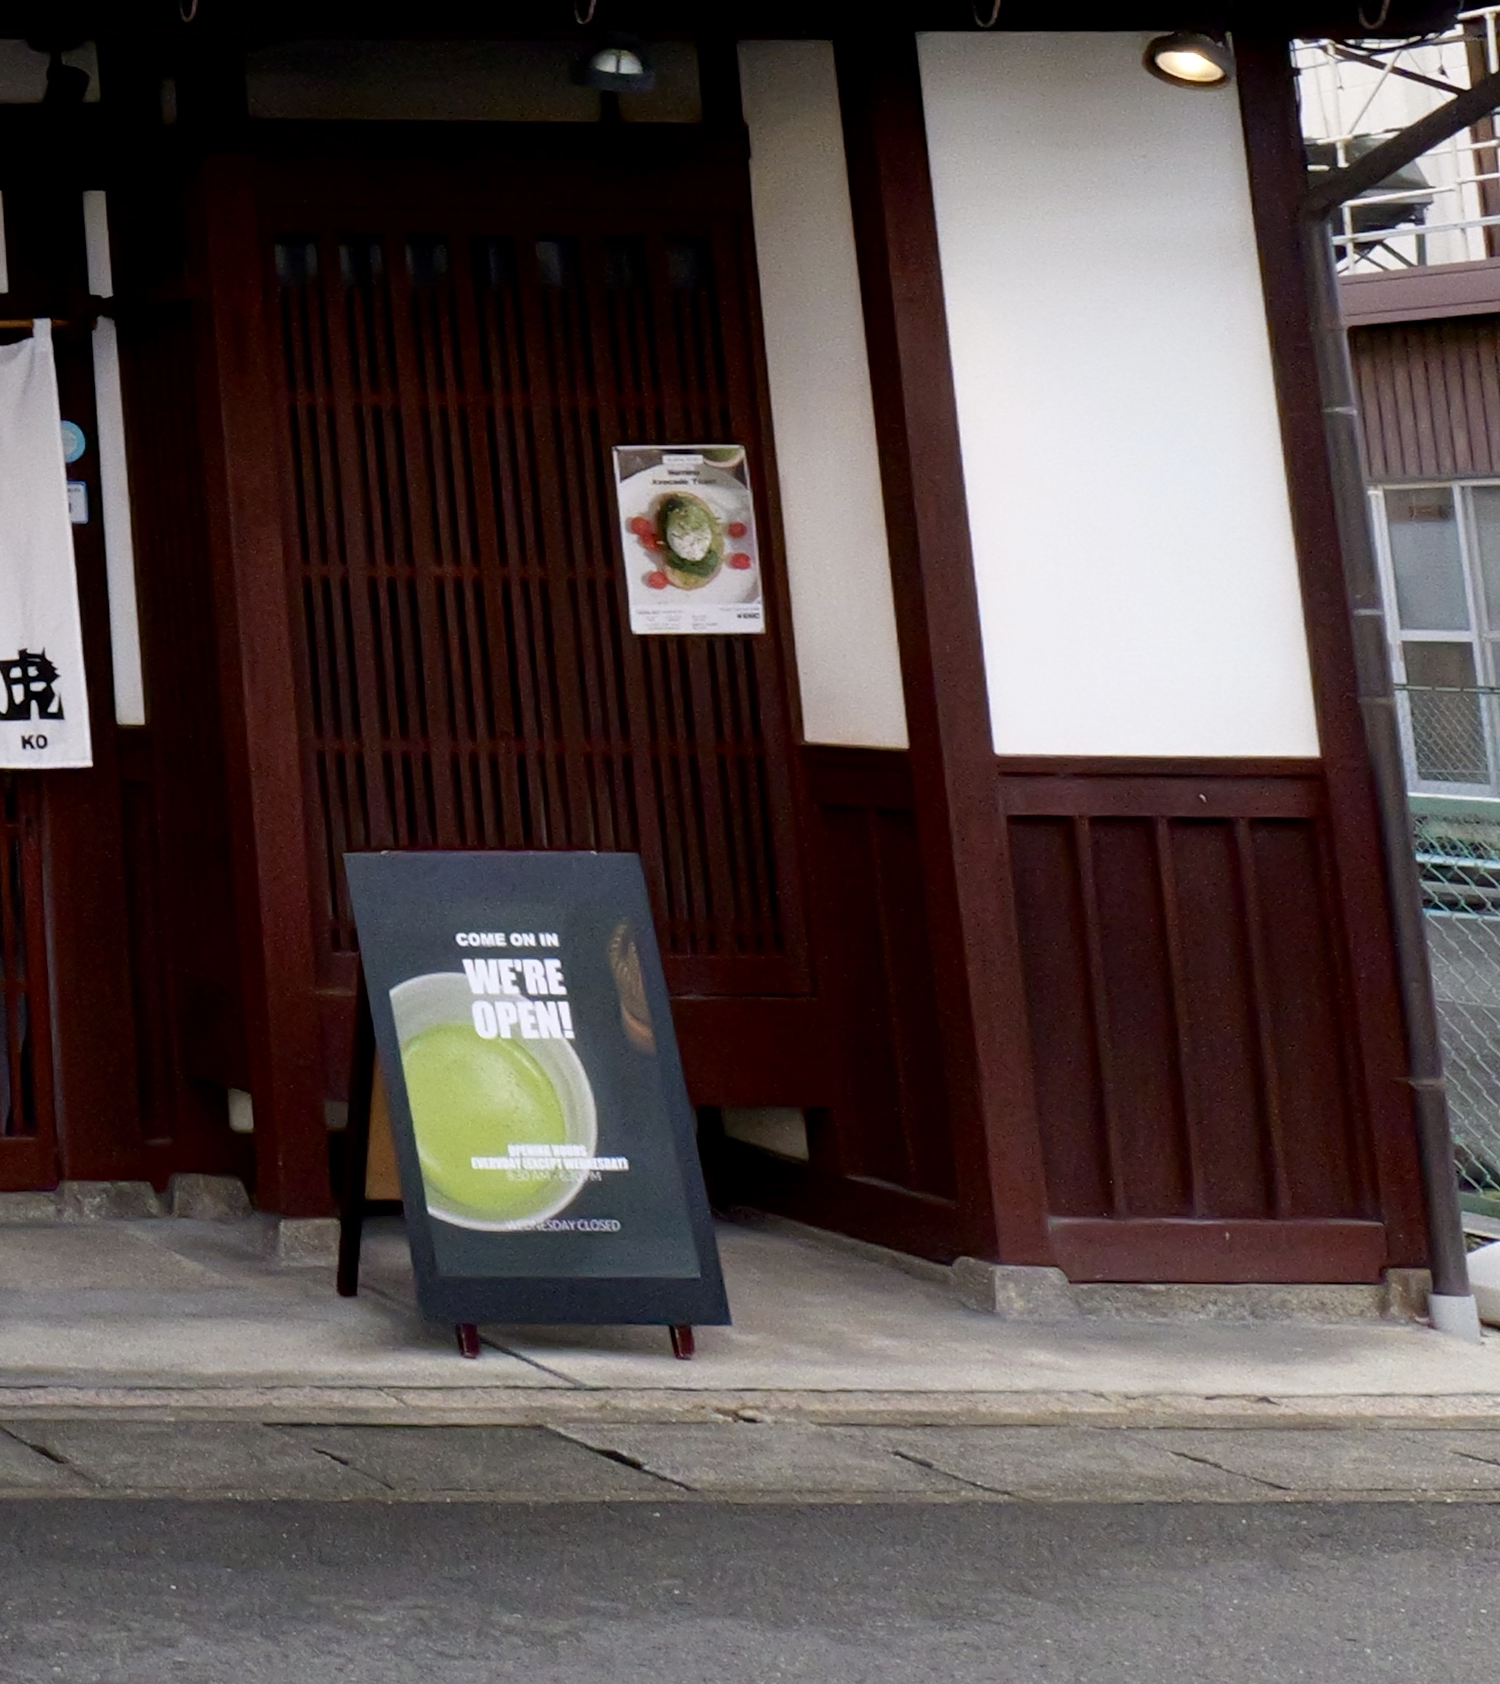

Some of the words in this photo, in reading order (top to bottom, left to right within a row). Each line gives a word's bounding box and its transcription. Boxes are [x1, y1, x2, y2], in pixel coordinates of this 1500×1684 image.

[21, 734, 48, 750] KO
[455, 932, 507, 947] COME
[509, 932, 537, 947] ON
[538, 932, 560, 947] IN
[462, 958, 568, 995] WE'RE
[471, 1000, 576, 1039] OPEN!
[576, 1219, 621, 1232] CLOSED
